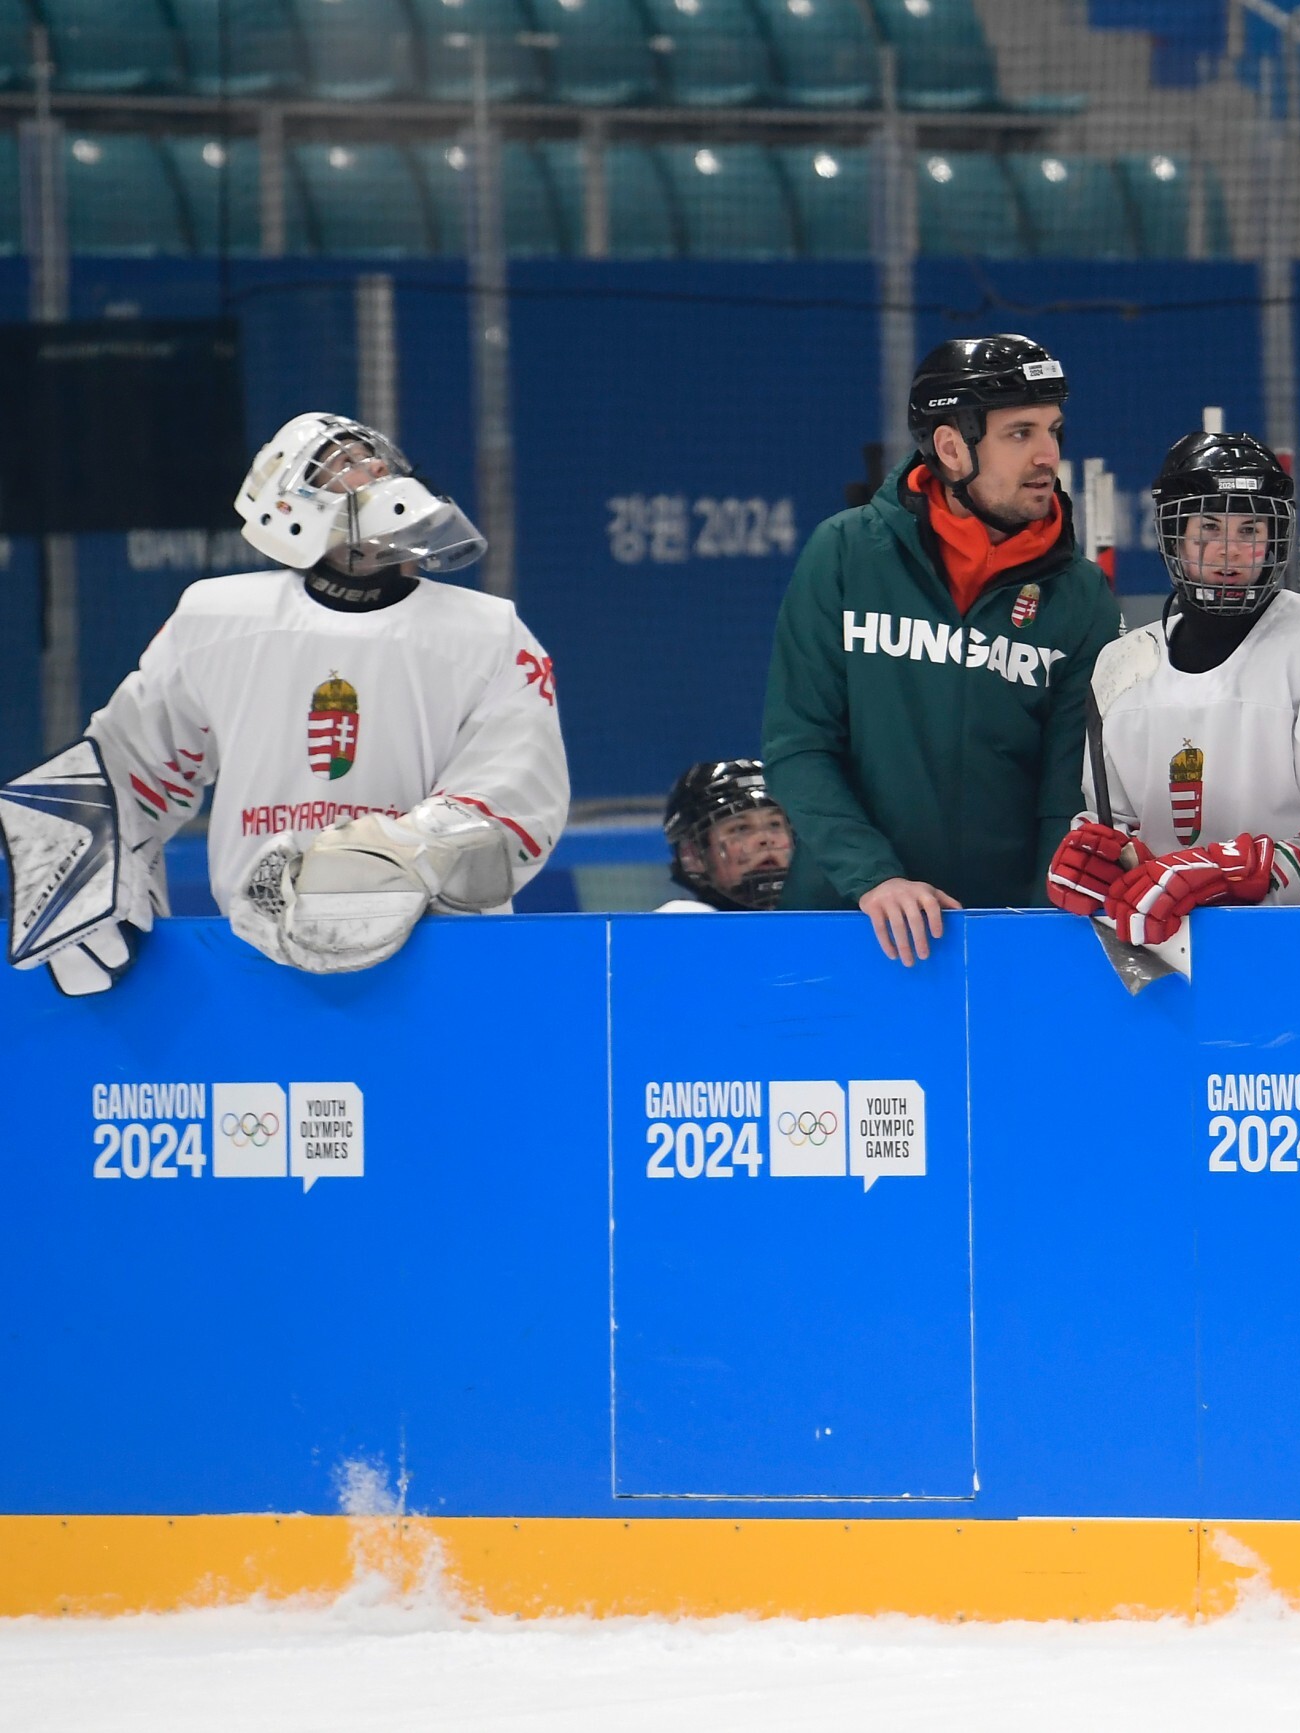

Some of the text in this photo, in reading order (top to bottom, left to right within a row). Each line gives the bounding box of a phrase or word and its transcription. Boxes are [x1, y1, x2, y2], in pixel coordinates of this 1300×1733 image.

[928, 397, 958, 407] CCM
[1230, 448, 1241, 458] 7
[1218, 481, 1235, 490] 2024
[695, 497, 796, 556] 2024
[843, 610, 1067, 688] HUNGARY
[92, 1083, 206, 1120] GANGWON
[307, 1099, 347, 1117] YOUTH
[645, 1081, 761, 1118] GANGWON
[867, 1098, 907, 1115] YOUTH
[301, 1121, 353, 1139] OLYMPIC
[860, 1119, 914, 1137] OLYMPIC
[93, 1123, 207, 1179] 2024
[306, 1142, 349, 1160] GAMES
[646, 1122, 762, 1178] 2024
[865, 1141, 910, 1158] GAMES
